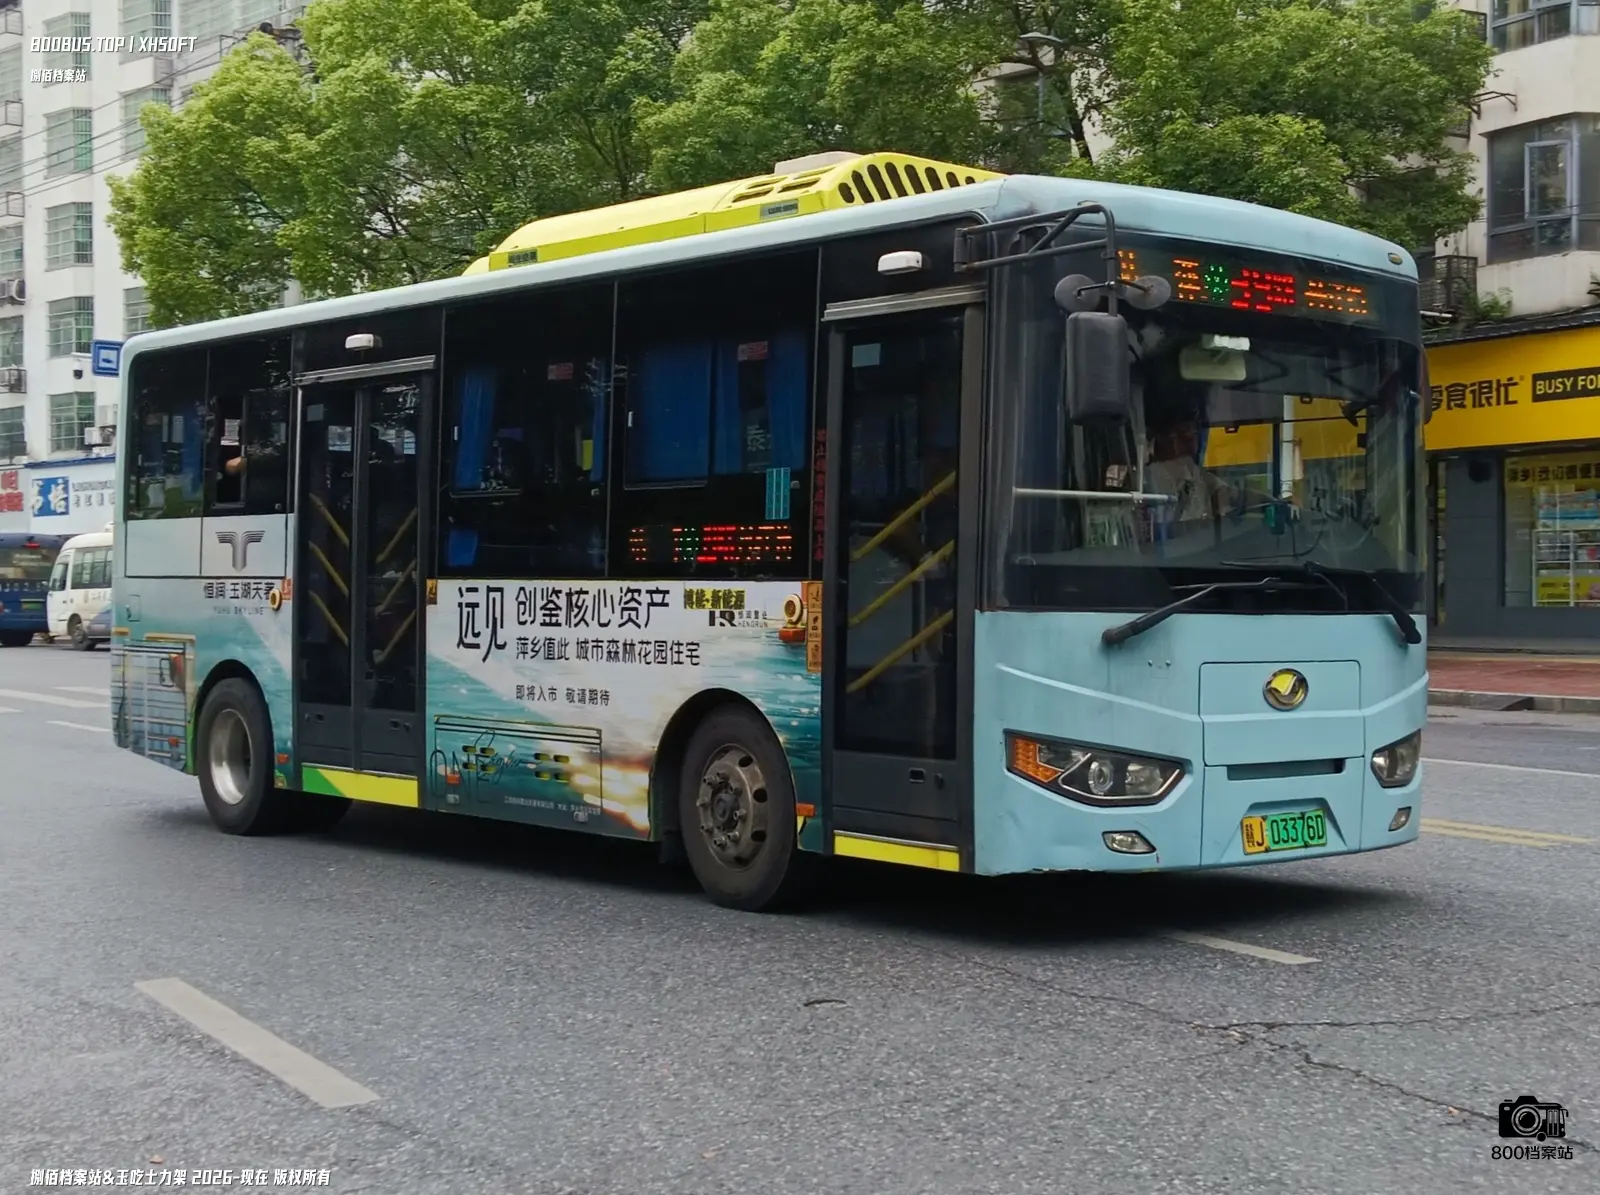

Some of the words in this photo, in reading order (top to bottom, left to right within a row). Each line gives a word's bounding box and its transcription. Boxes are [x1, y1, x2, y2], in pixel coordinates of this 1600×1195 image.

[1535, 377, 1574, 395] BUSY
[1577, 373, 1600, 391] FO
[515, 586, 670, 629] 创鉴核心资产
[457, 585, 507, 663] 远见
[516, 636, 570, 661] 萍乡值此
[576, 637, 700, 666] 城市森林花园住宅
[516, 684, 557, 702] 即将入市
[565, 687, 610, 706] 敬请期待
